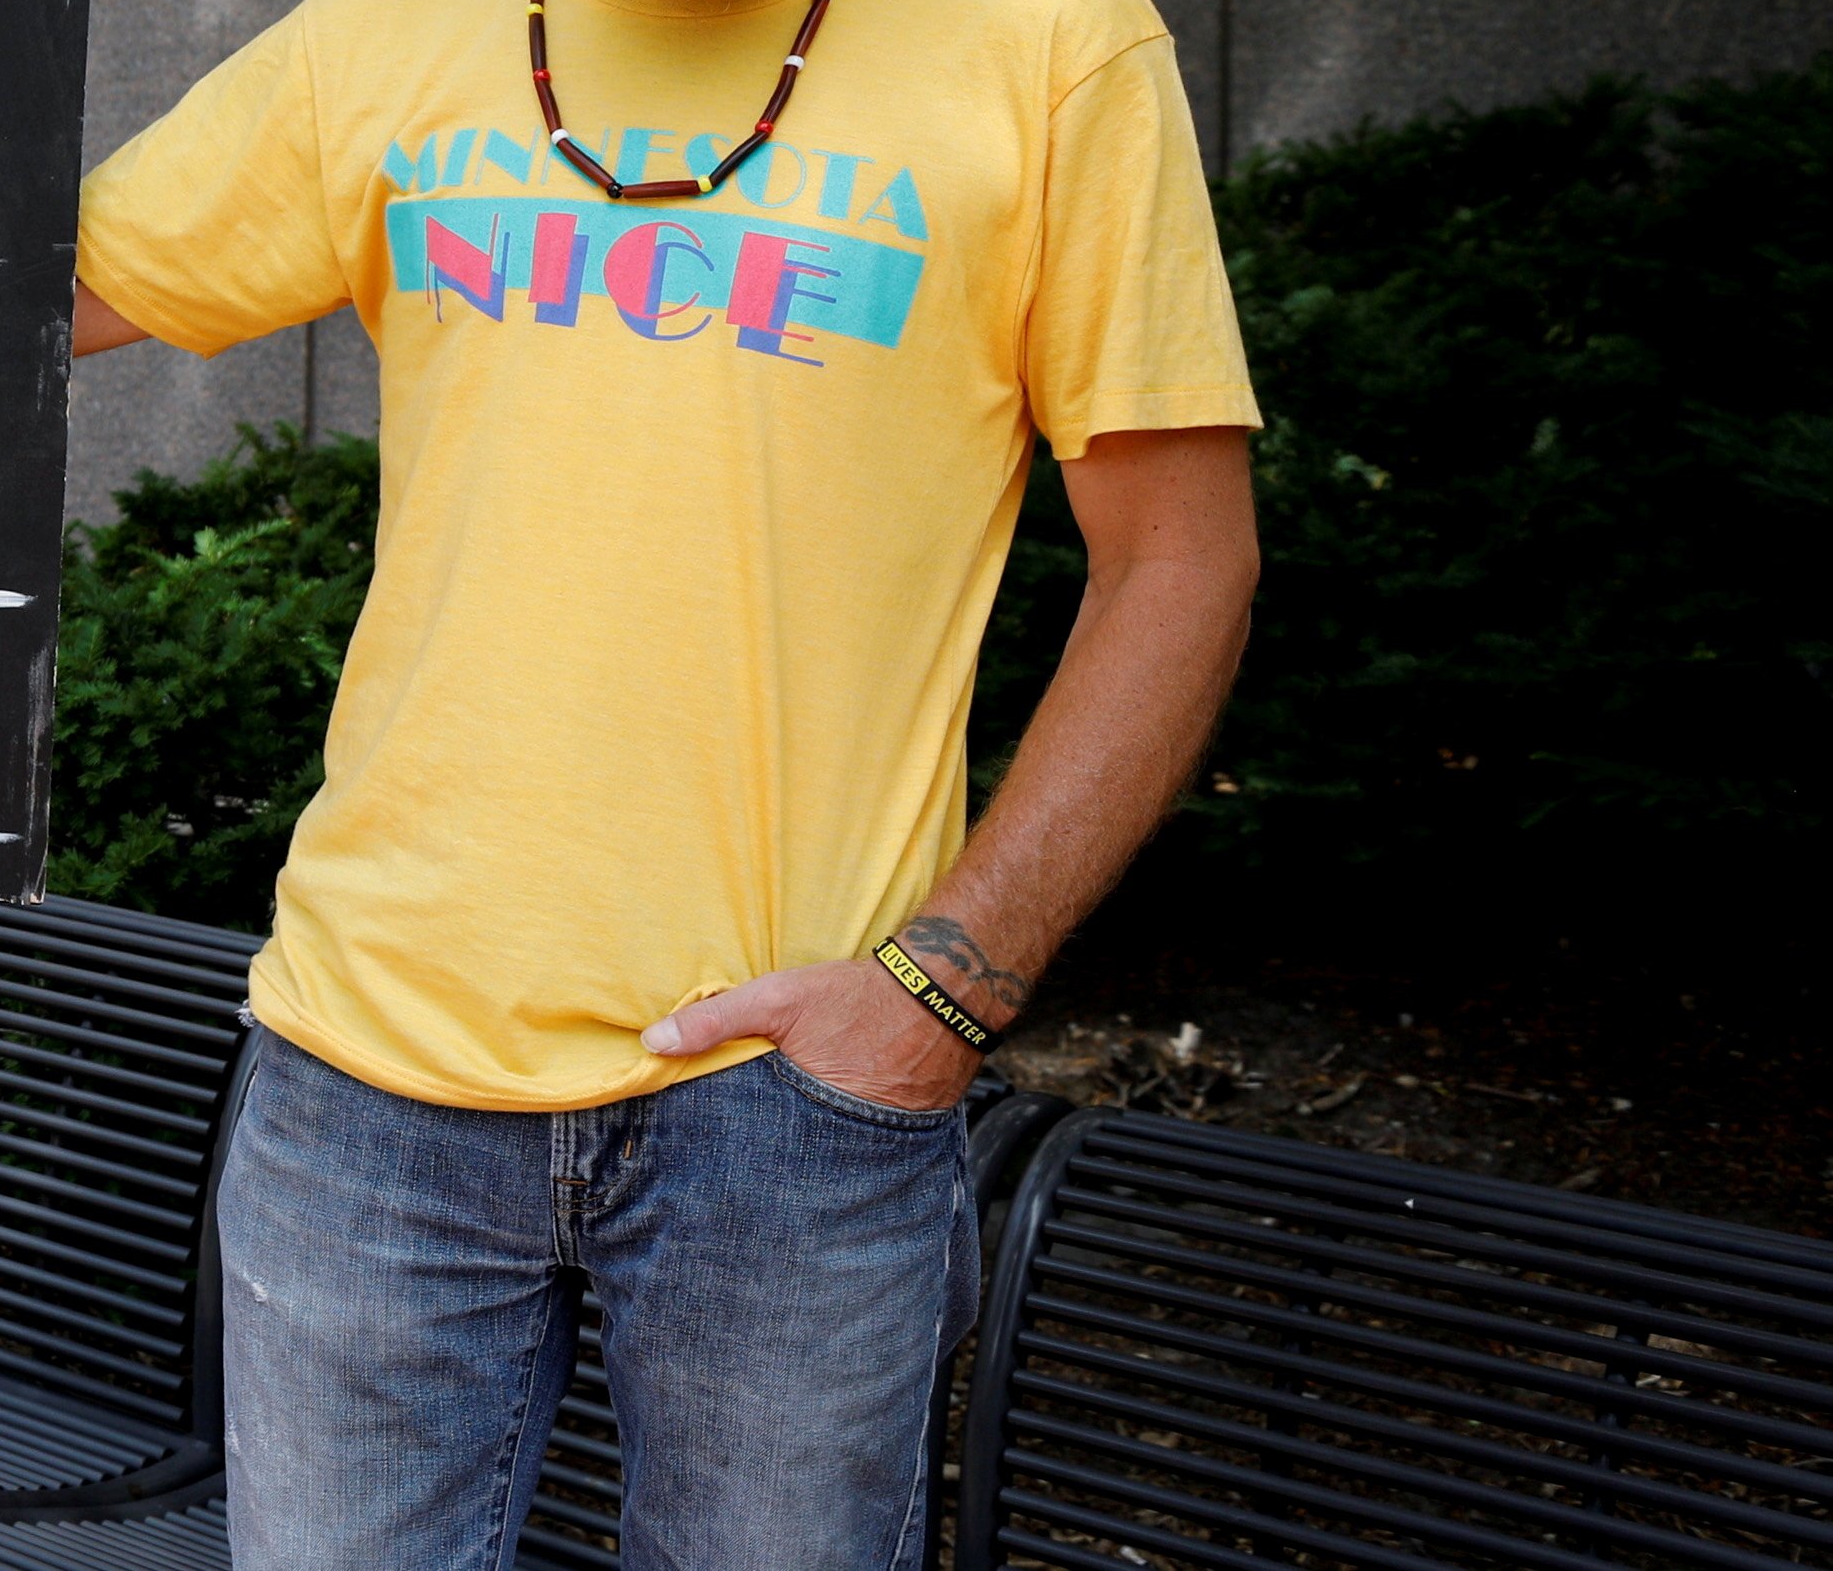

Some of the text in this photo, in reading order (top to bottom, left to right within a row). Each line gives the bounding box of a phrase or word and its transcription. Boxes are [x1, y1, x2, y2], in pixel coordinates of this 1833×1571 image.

[381, 127, 930, 242] MINNESOTA
[425, 211, 843, 369] NICE
[881, 946, 987, 1046] LIVES MATTER
